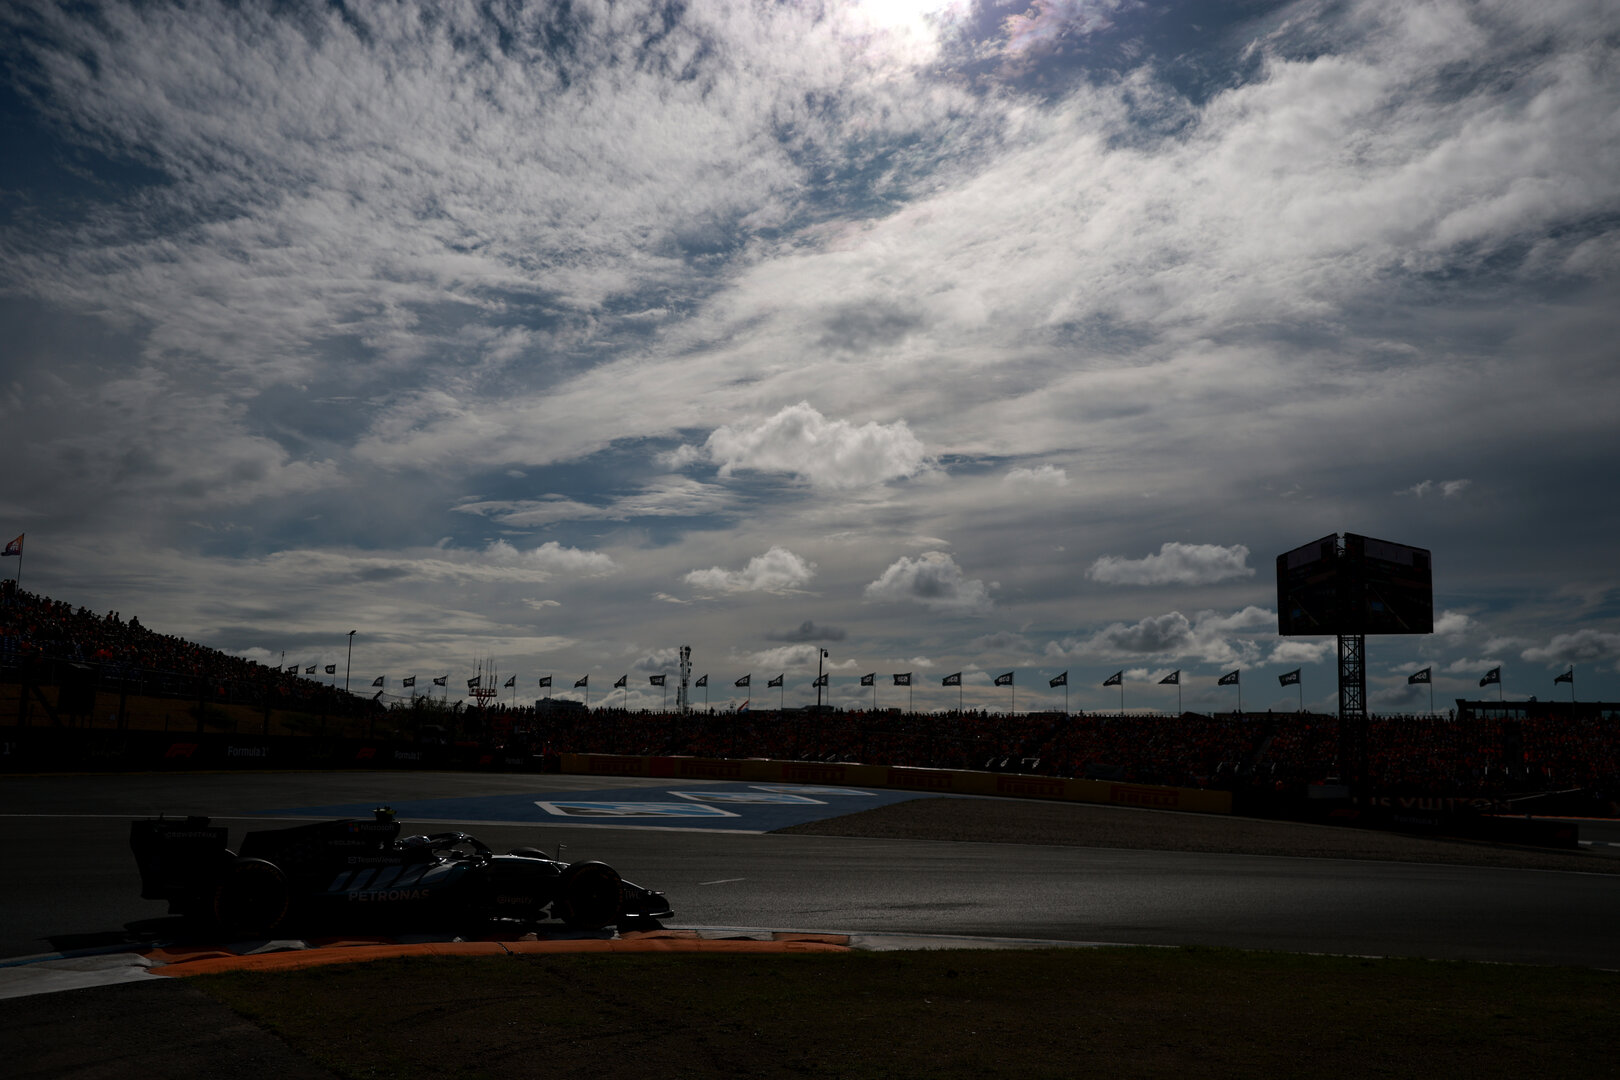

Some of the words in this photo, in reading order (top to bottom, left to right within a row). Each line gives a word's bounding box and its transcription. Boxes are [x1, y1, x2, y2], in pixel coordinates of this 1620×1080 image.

[997, 776, 1066, 796] PIRELLI
[1110, 784, 1180, 807] PIRELLI
[347, 888, 430, 902] PETRONAS
